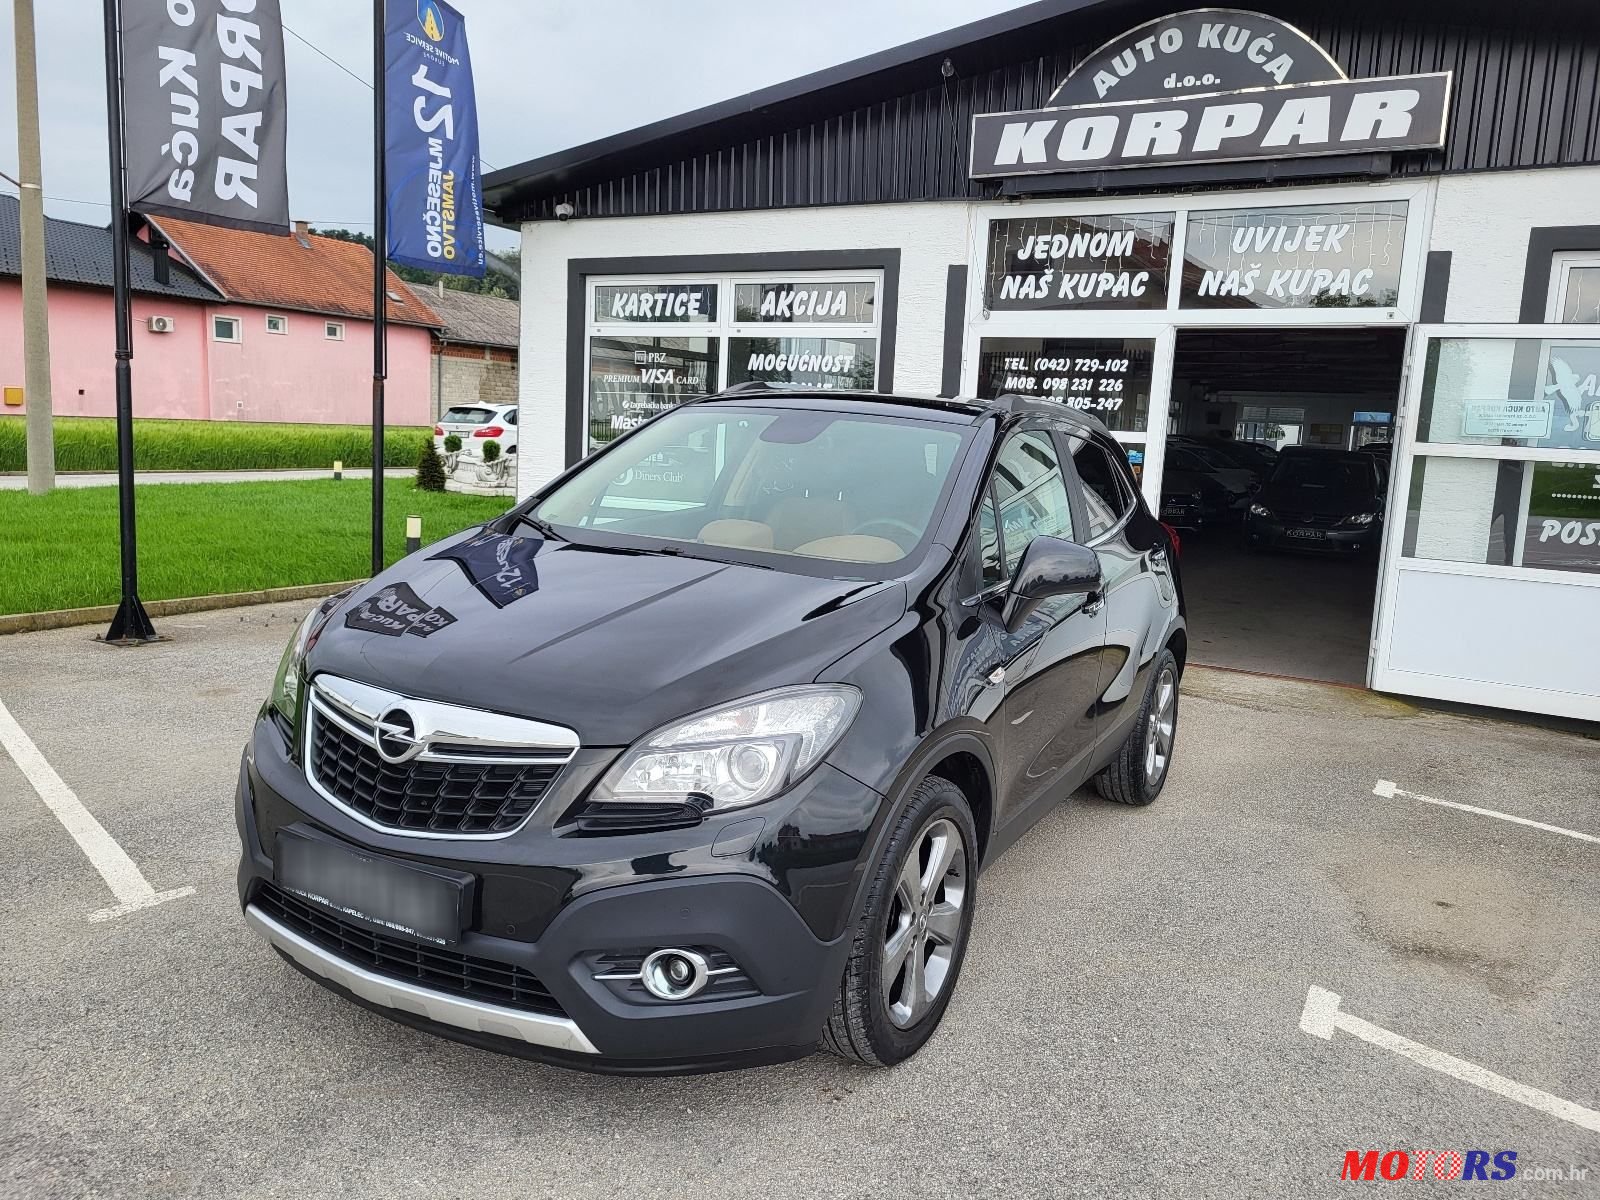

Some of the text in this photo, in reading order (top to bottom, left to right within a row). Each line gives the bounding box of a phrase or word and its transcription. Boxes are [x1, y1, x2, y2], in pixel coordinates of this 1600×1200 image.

[1092, 23, 1294, 100] AUTO KUĆA
[1163, 72, 1221, 89] d.o.o.
[993, 88, 1421, 166] KORPAR
[1017, 231, 1136, 261] JEDNOM
[1232, 224, 1351, 254] UVIJEK
[999, 268, 1150, 300] NAŠ KUPAC
[1197, 263, 1374, 298] NAŠ KUPAC
[611, 292, 702, 319] KARTICE
[760, 290, 848, 318] AKCIJA
[648, 352, 667, 363] PBZ
[747, 350, 855, 373] MOGUĆNOST
[1004, 357, 1129, 373] TEL. (042) 729-102
[603, 369, 699, 385] PREMIUM VISA CARD
[1042, 377, 1068, 391] 098
[1070, 378, 1093, 391] 231
[1098, 378, 1124, 392] 226
[635, 470, 683, 482] Diners Club
[1539, 519, 1600, 546] POS
